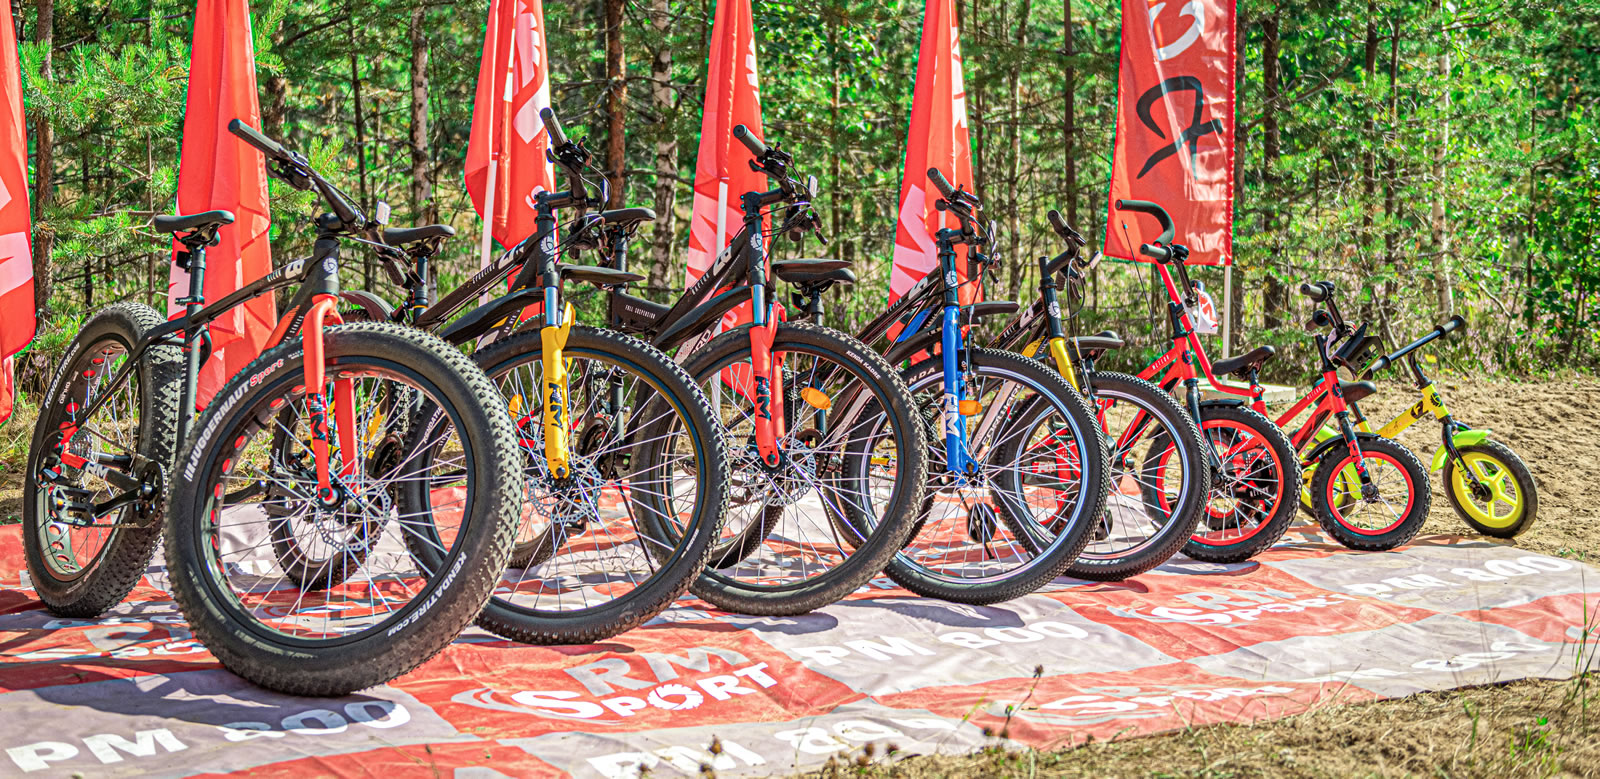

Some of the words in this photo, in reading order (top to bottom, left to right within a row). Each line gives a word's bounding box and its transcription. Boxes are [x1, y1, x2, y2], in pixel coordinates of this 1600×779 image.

[755, 375, 772, 422] RM
[908, 366, 936, 385] NDA
[188, 380, 251, 466] JUGGERNAUT
[249, 358, 285, 388] Sport
[548, 382, 563, 430] RM
[944, 392, 961, 438] RM
[1451, 556, 1574, 582] 800
[791, 635, 937, 666] PM
[938, 620, 1089, 649] 800
[510, 662, 779, 720] SPORT
[562, 645, 751, 698] RM
[5, 727, 190, 773] PM
[216, 700, 412, 742] 800
